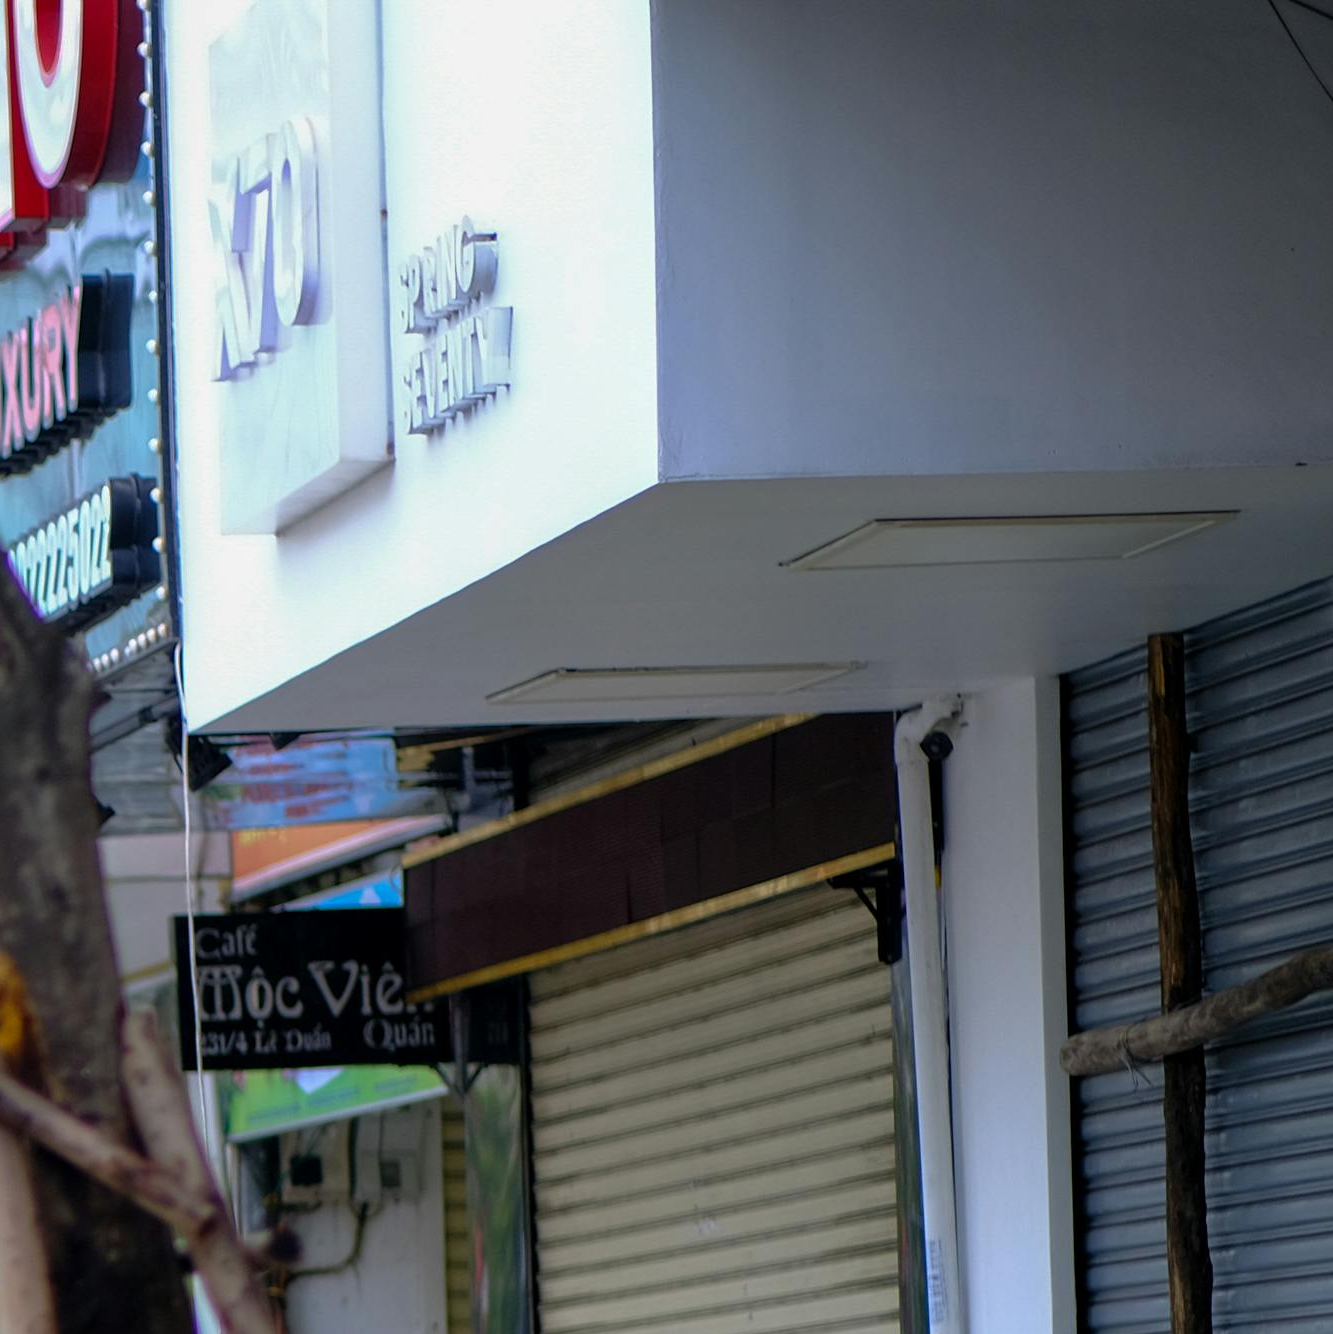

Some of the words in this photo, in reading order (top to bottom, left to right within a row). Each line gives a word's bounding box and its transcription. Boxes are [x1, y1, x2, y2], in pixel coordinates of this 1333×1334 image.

[397, 215, 485, 334] SPRING
[401, 310, 499, 436] SEVENTY
[197, 924, 258, 959] Café
[198, 964, 304, 1029] Mộc
[308, 958, 435, 1018] Viê
